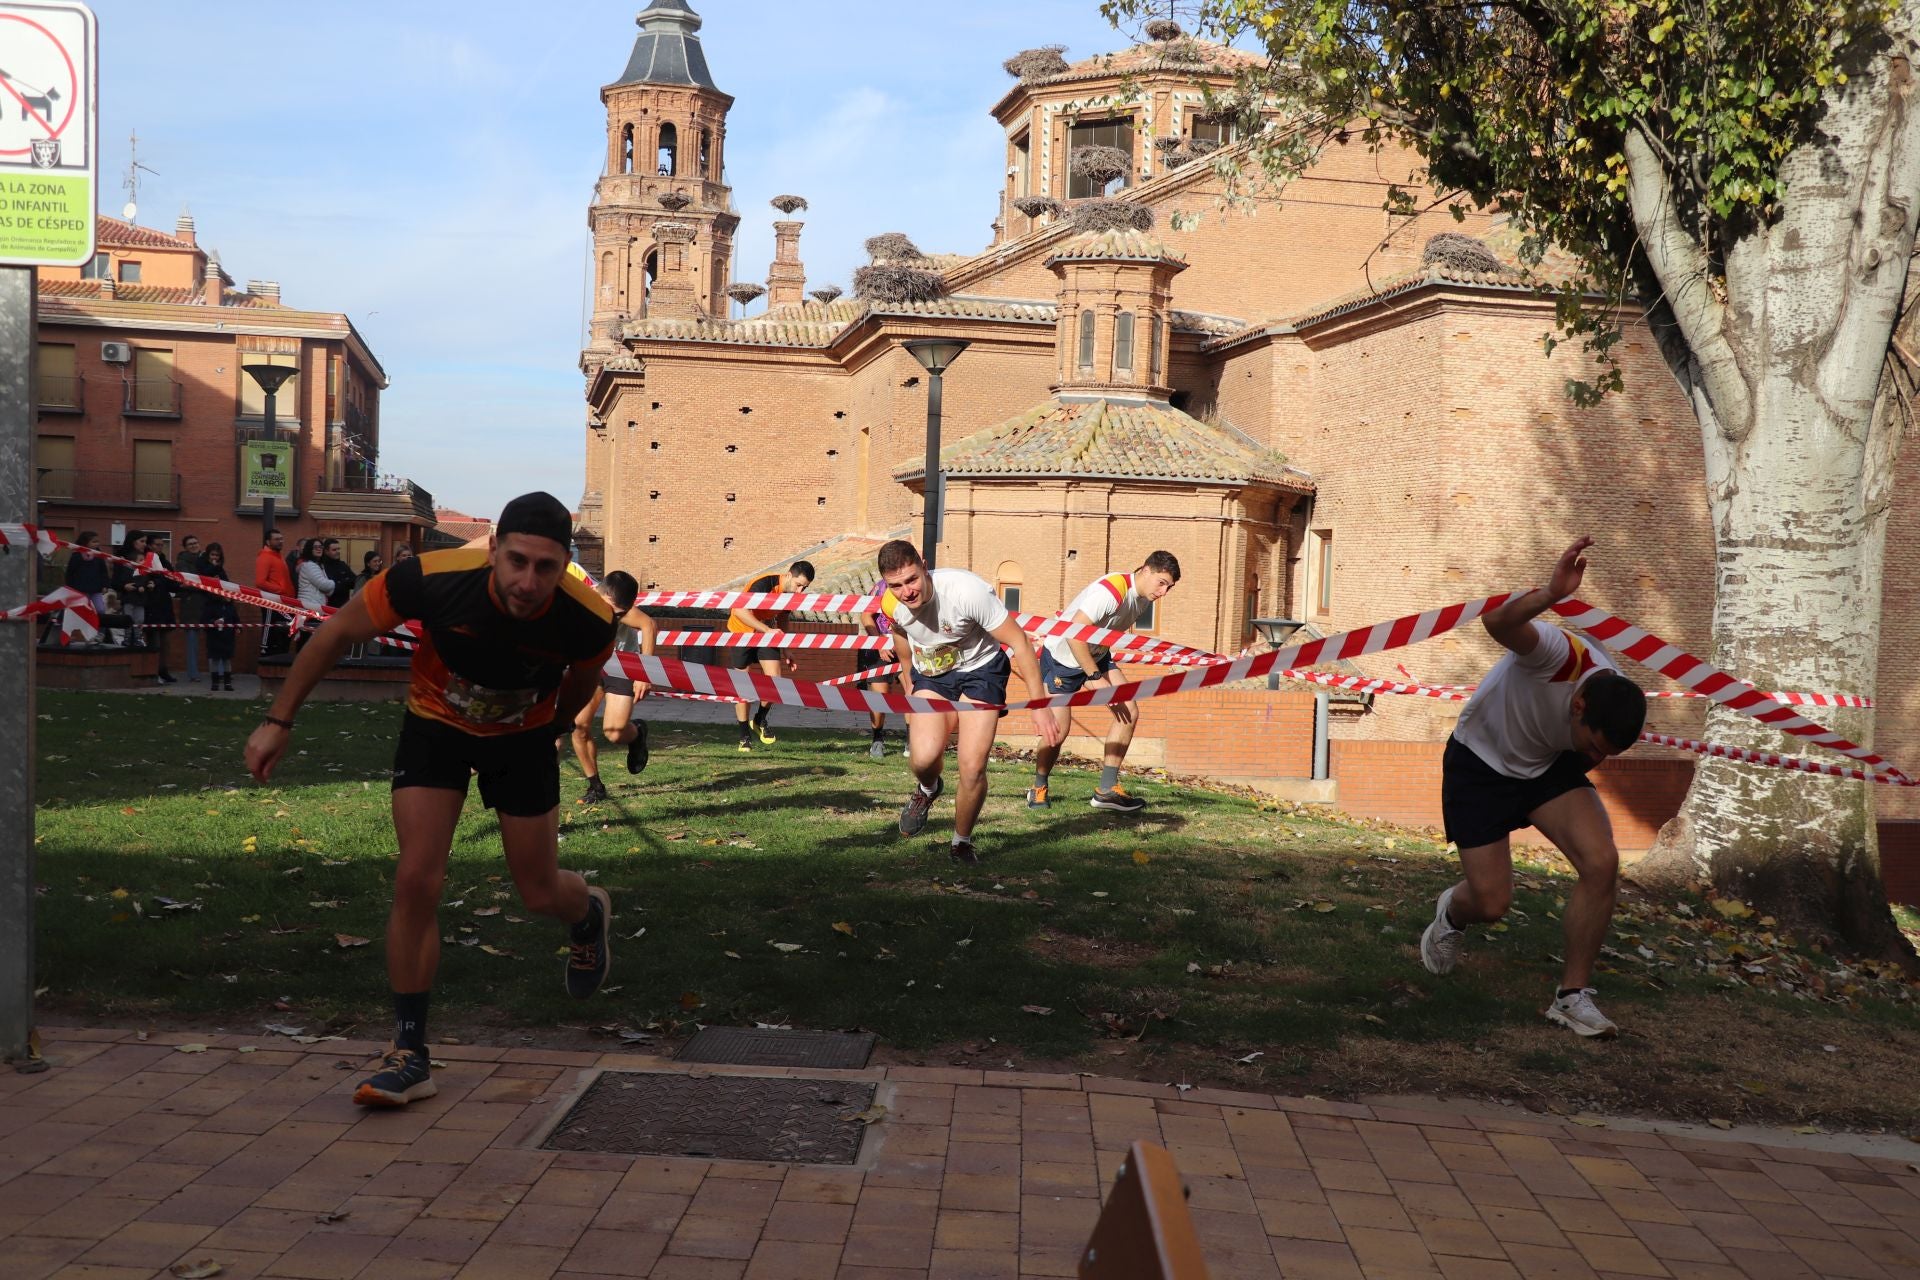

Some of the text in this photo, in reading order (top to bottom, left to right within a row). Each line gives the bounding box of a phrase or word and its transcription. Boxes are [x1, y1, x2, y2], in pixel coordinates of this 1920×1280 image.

[10, 182, 26, 194] LA
[29, 183, 66, 195] ZONA
[12, 200, 70, 213] INFANTIL
[17, 217, 33, 229] DE
[37, 216, 85, 231] CÉSPED
[925, 653, 954, 671] 123
[466, 700, 503, 717] 85
